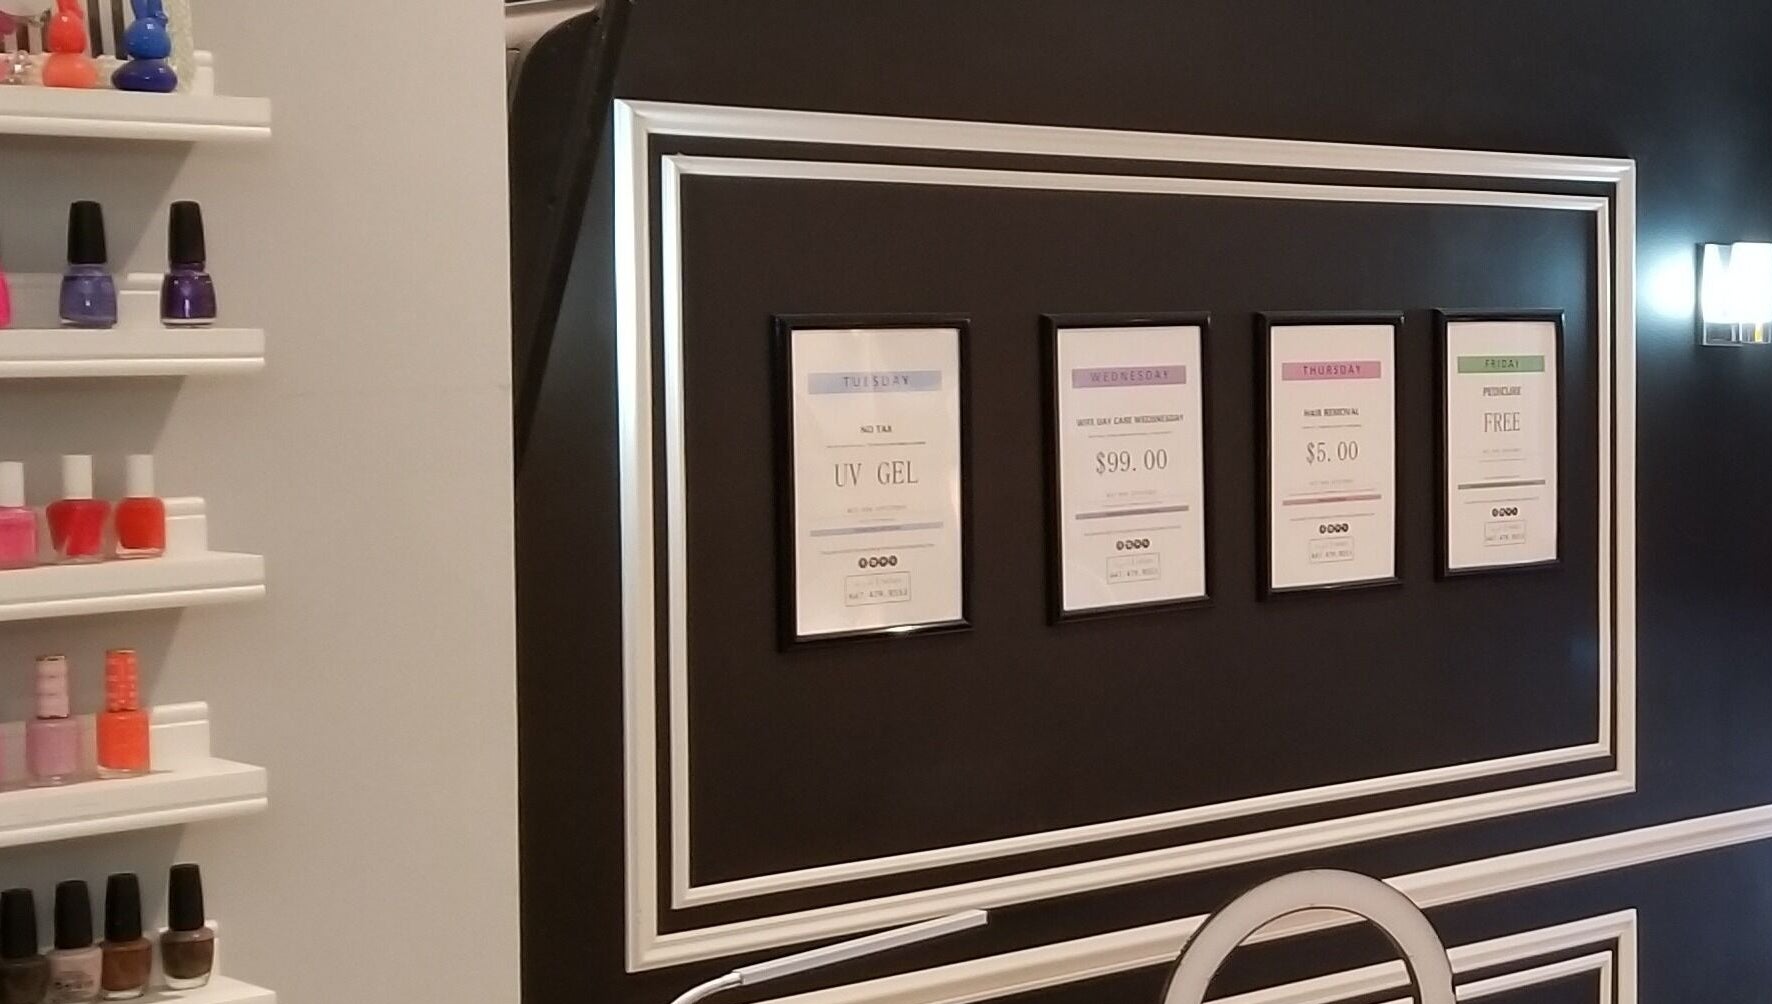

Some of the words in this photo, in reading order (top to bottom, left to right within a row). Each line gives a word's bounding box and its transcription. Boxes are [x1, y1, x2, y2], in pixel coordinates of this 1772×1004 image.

[1484, 359, 1519, 369] FRIDAY
[1303, 365, 1361, 376] THURSDAY
[843, 375, 910, 388] TUESDAY
[1090, 370, 1169, 383] WEDNESDAY
[1482, 386, 1521, 397] PEDICURE
[1303, 408, 1322, 417] HAIR
[1323, 407, 1360, 417] REMOVAL
[1484, 411, 1521, 433] FREE
[860, 425, 874, 434] NO
[876, 424, 893, 433] TAX
[834, 462, 863, 488] UV
[876, 460, 920, 486] GEL
